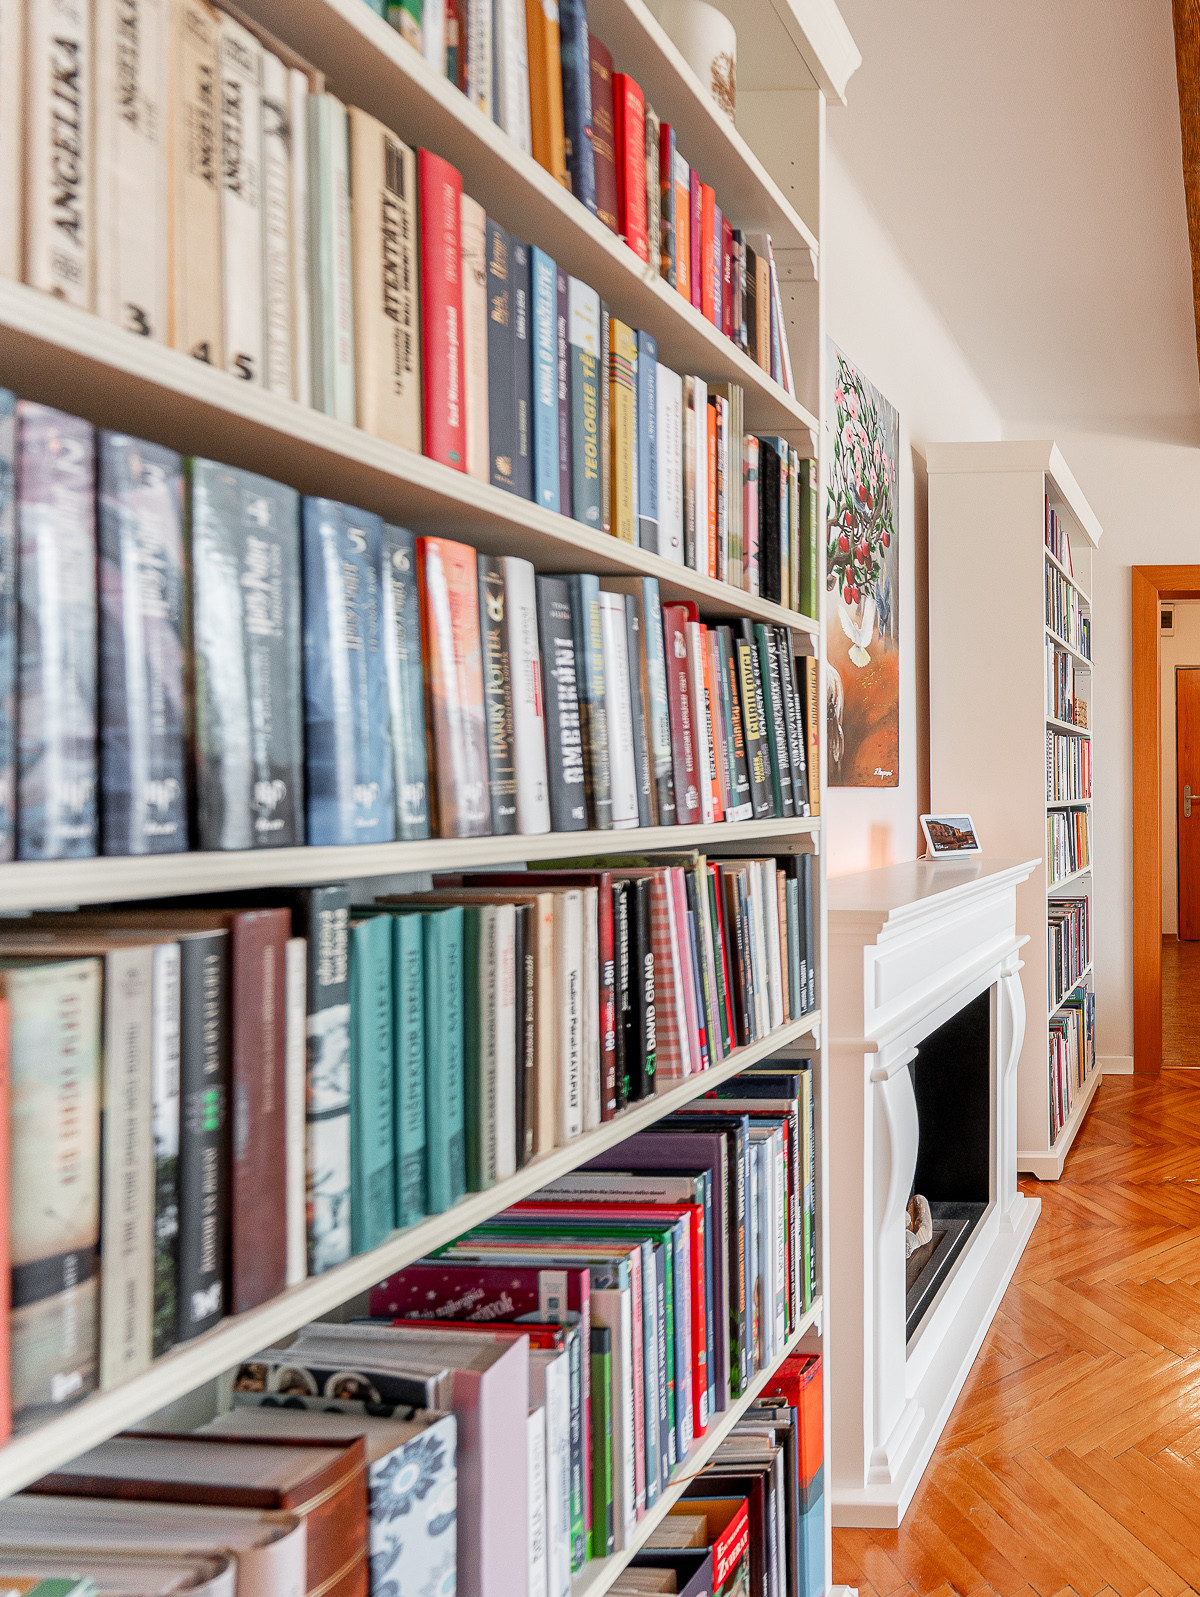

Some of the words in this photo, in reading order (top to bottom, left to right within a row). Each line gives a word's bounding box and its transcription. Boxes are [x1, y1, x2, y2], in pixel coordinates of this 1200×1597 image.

[50, 35, 83, 246] ANGELIKA
[124, 302, 152, 337] 3
[232, 352, 255, 382] 5
[540, 363, 554, 407] KNIHA
[583, 383, 598, 480] TEOLOGIE
[345, 527, 368, 555] 5
[393, 546, 411, 570] 6
[485, 628, 505, 696] POTTER
[488, 698, 508, 759] HARRY
[550, 636, 585, 785] AMERIKÁNI
[731, 705, 744, 749] minúty
[405, 948, 421, 1024] FRENCH
[446, 941, 459, 1032] MASON
[603, 959, 616, 987] 2011
[643, 952, 656, 1003] CRAIG
[376, 957, 390, 1053] QUEEN
[645, 1004, 657, 1052] DAVID
[603, 1030, 616, 1053] 100
[377, 1060, 391, 1149] ELLERY
[447, 1038, 460, 1117] PERRY
[716, 1529, 749, 1584] ZVIERAT
